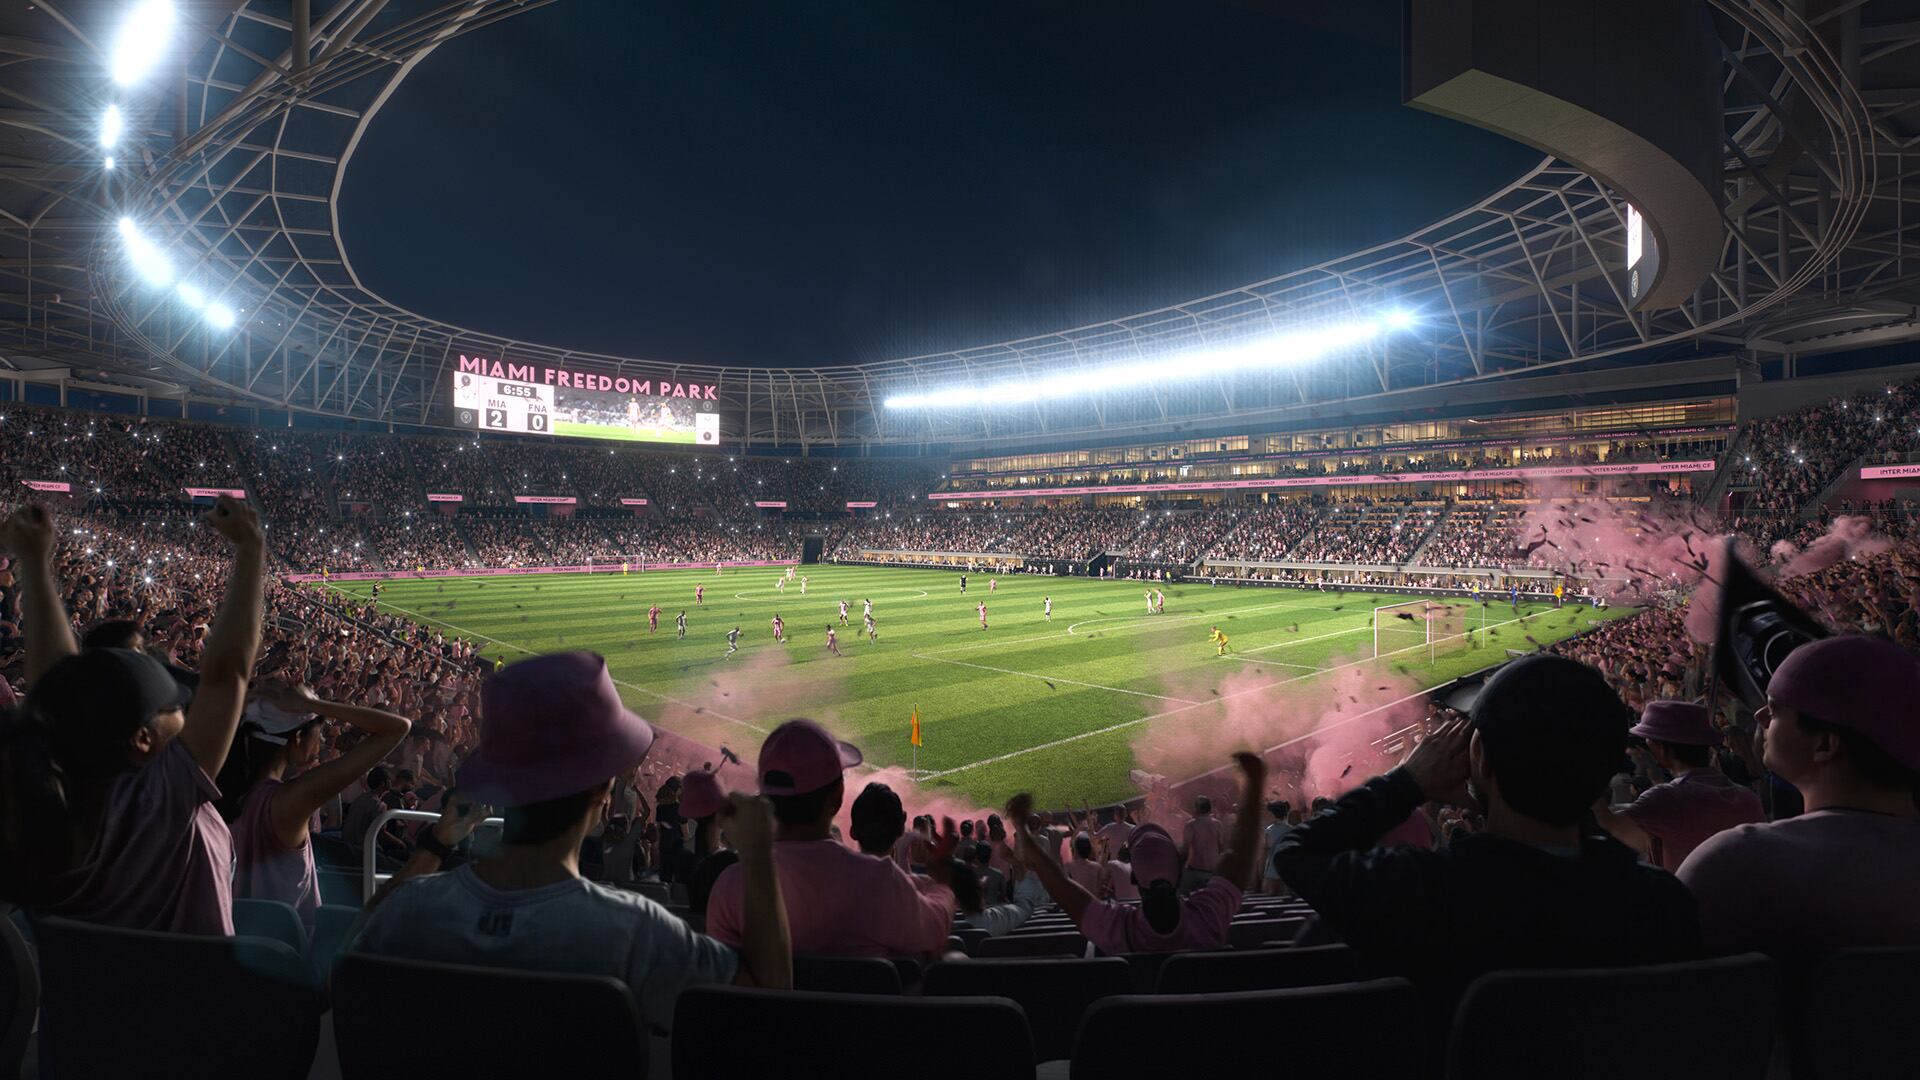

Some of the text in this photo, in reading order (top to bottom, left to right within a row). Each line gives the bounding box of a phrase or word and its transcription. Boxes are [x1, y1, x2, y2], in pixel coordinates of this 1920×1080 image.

[460, 354, 718, 400] MIAMI FREEDOM PARK
[503, 385, 531, 397] 6:55
[488, 399, 506, 408] MIA
[528, 404, 547, 413] FNA
[490, 410, 502, 427] 2
[532, 415, 544, 430] 0
